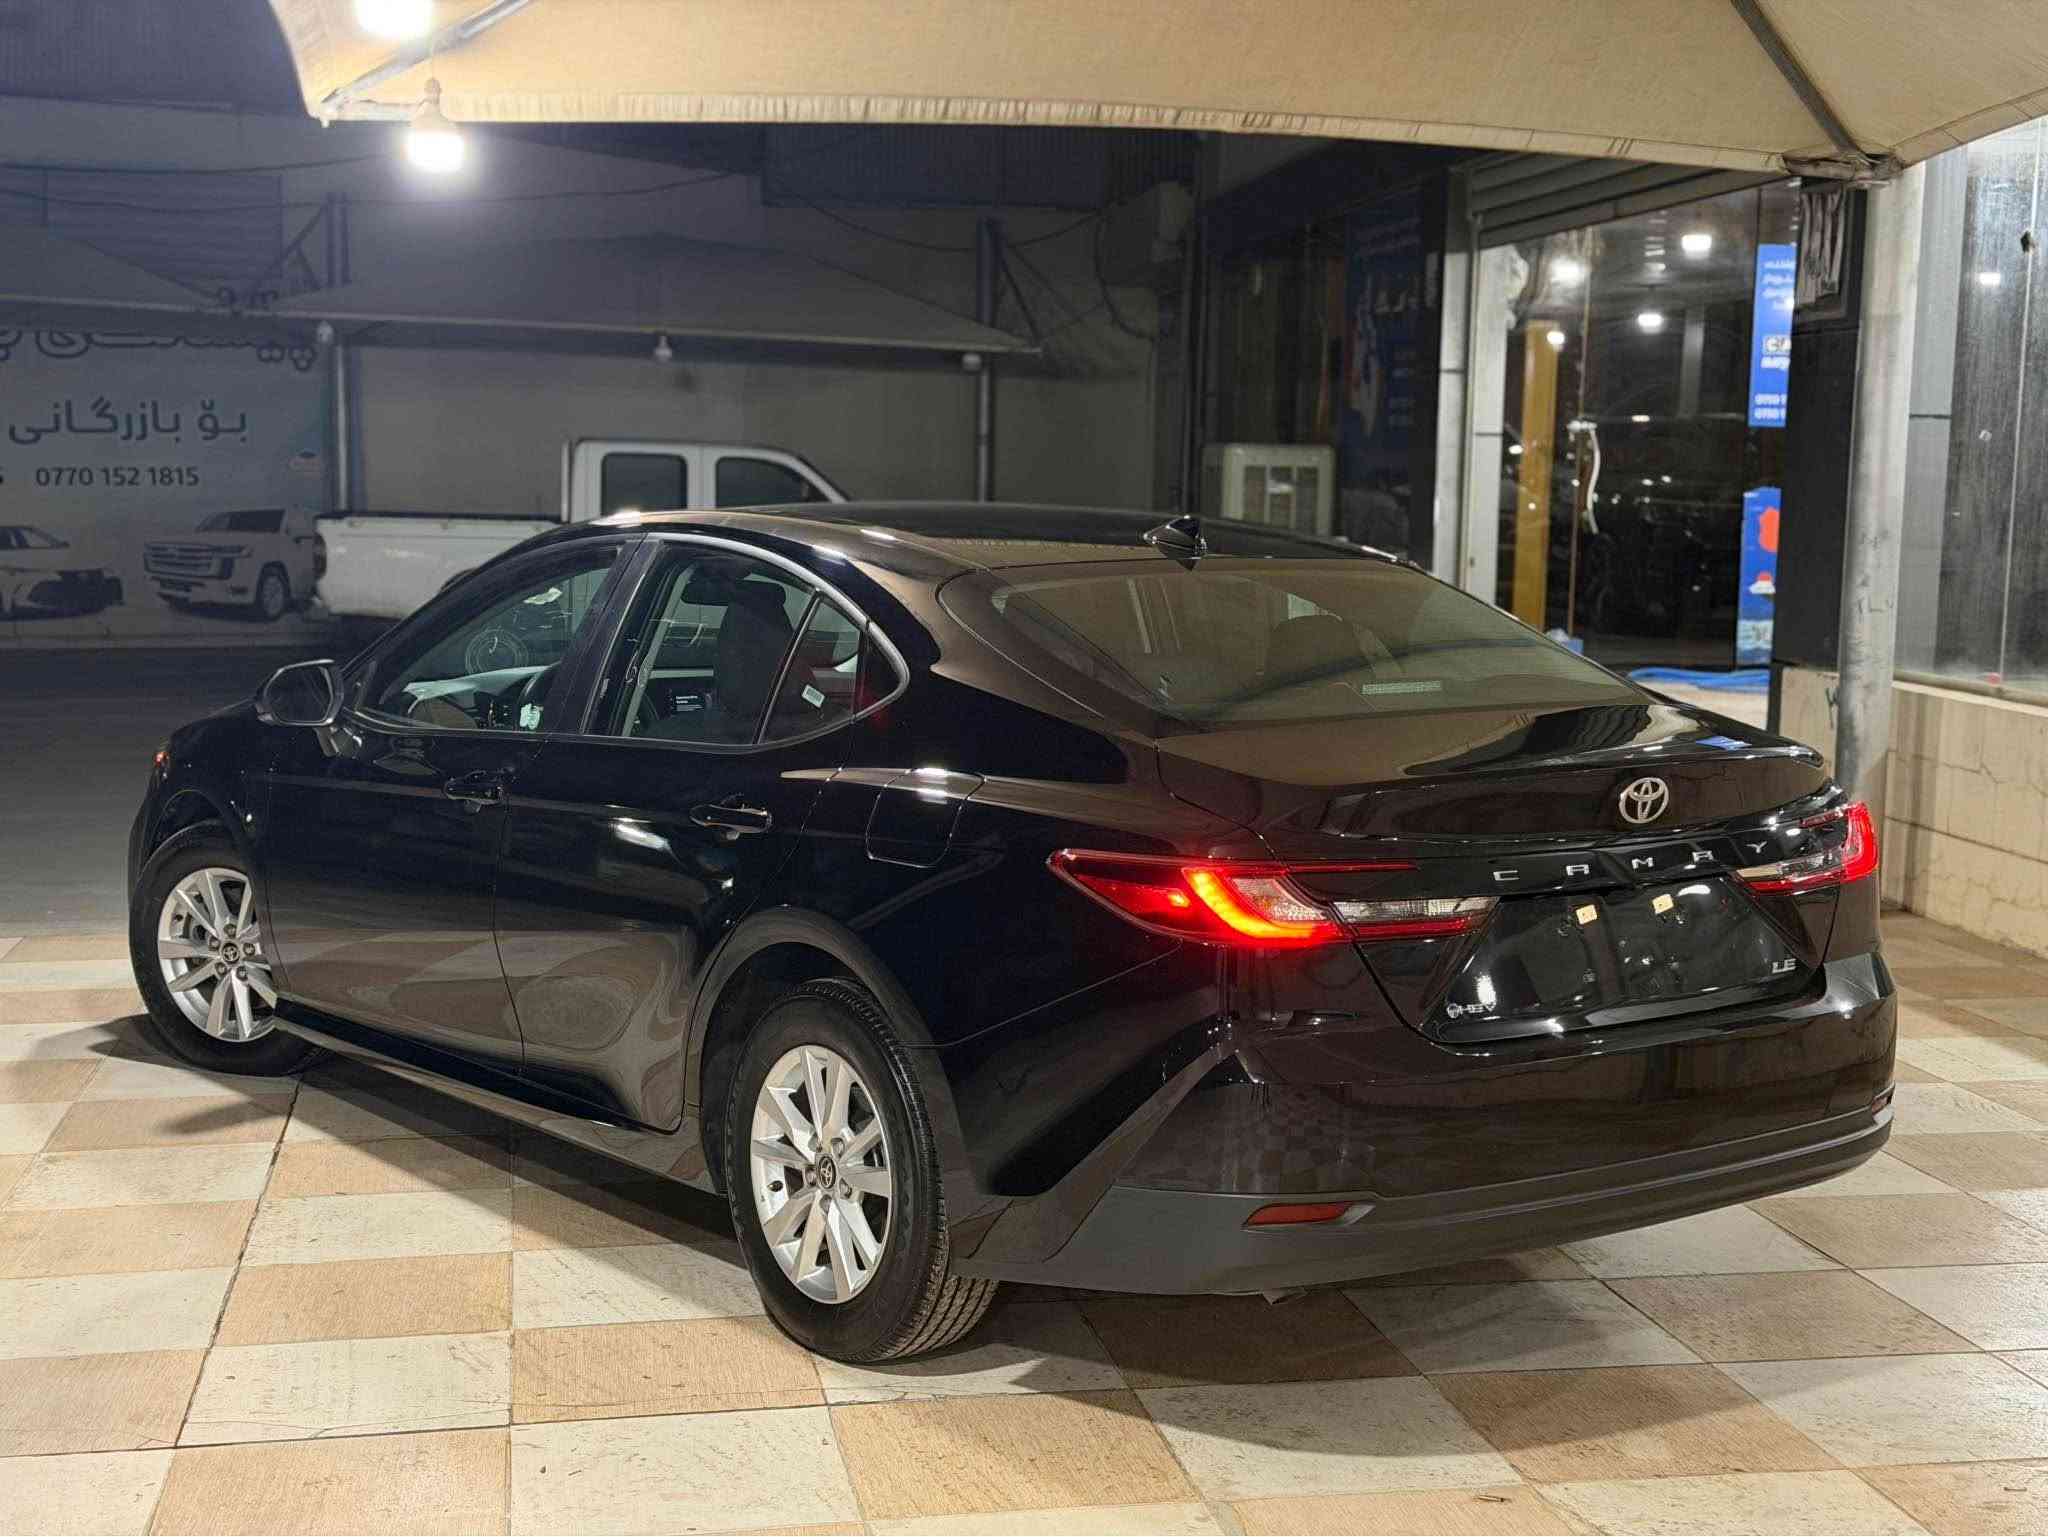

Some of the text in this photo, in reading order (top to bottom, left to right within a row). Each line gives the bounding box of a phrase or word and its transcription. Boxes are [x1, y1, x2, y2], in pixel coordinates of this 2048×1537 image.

[36, 466, 199, 486] 0770 152 1815
[1493, 841, 1768, 881] CAMRY
[1772, 958, 1797, 974] LE
